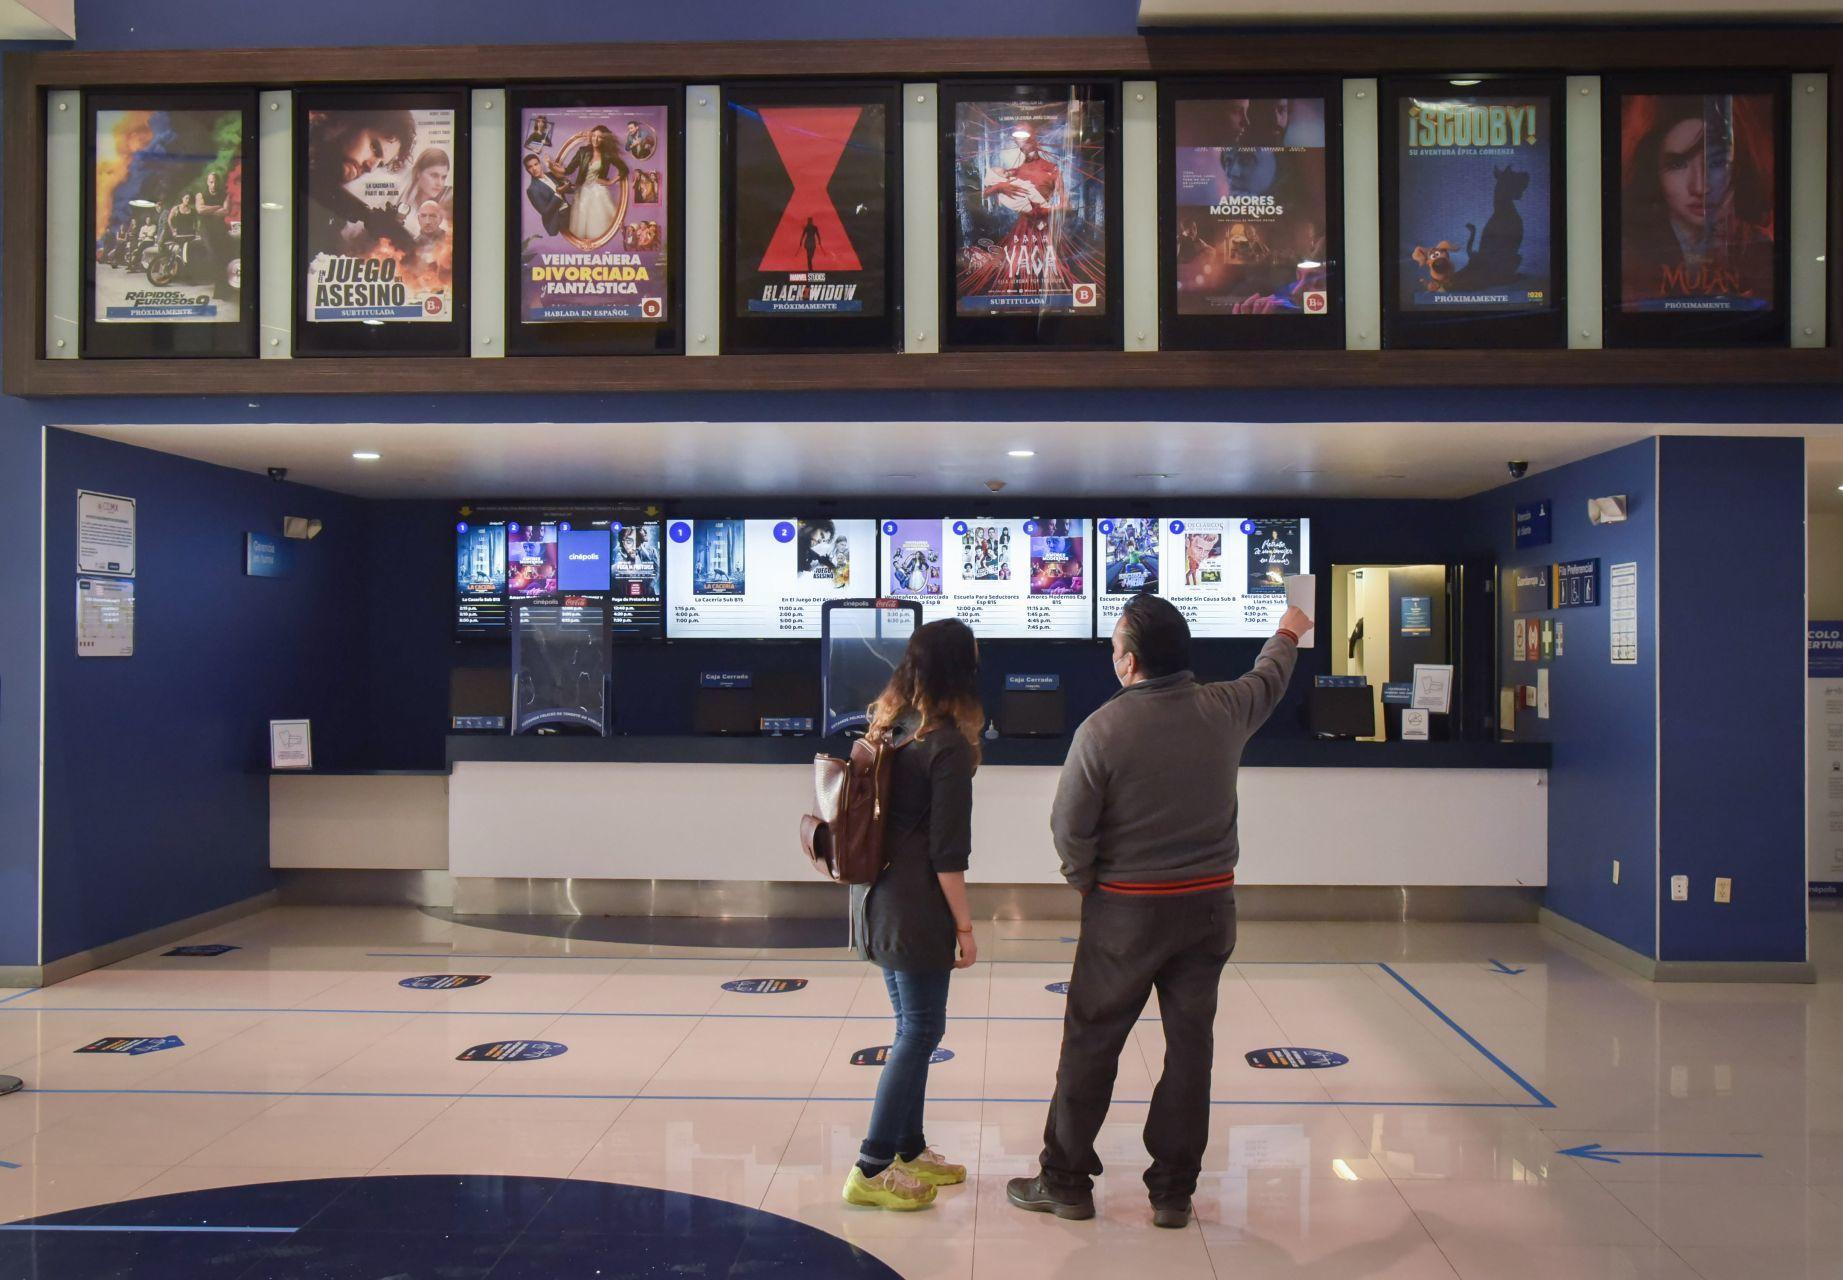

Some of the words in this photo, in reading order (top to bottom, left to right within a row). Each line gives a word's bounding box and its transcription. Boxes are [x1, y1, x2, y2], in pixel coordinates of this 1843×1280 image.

[1408, 104, 1536, 146] ¡SCOOBY!
[1219, 195, 1274, 205] AMORES
[1210, 205, 1283, 218] MODERNOS
[542, 252, 641, 265] VEINTEAÑERA
[1003, 245, 1058, 278] YAGA
[325, 258, 396, 283] JUEGO
[532, 266, 649, 280] DIVORCIADA
[1658, 262, 1752, 297] MULAN
[547, 281, 638, 294] FANTÁSTICA
[762, 285, 805, 301] BLACK
[809, 284, 856, 300] WIDOW
[126, 290, 180, 300] RÁPIDOS
[316, 284, 405, 306] ASESINO
[1080, 290, 1089, 299] B
[134, 298, 195, 307] FURIOSOS
[569, 553, 599, 561] cinépolis
[1567, 562, 1593, 574] Preferencial
